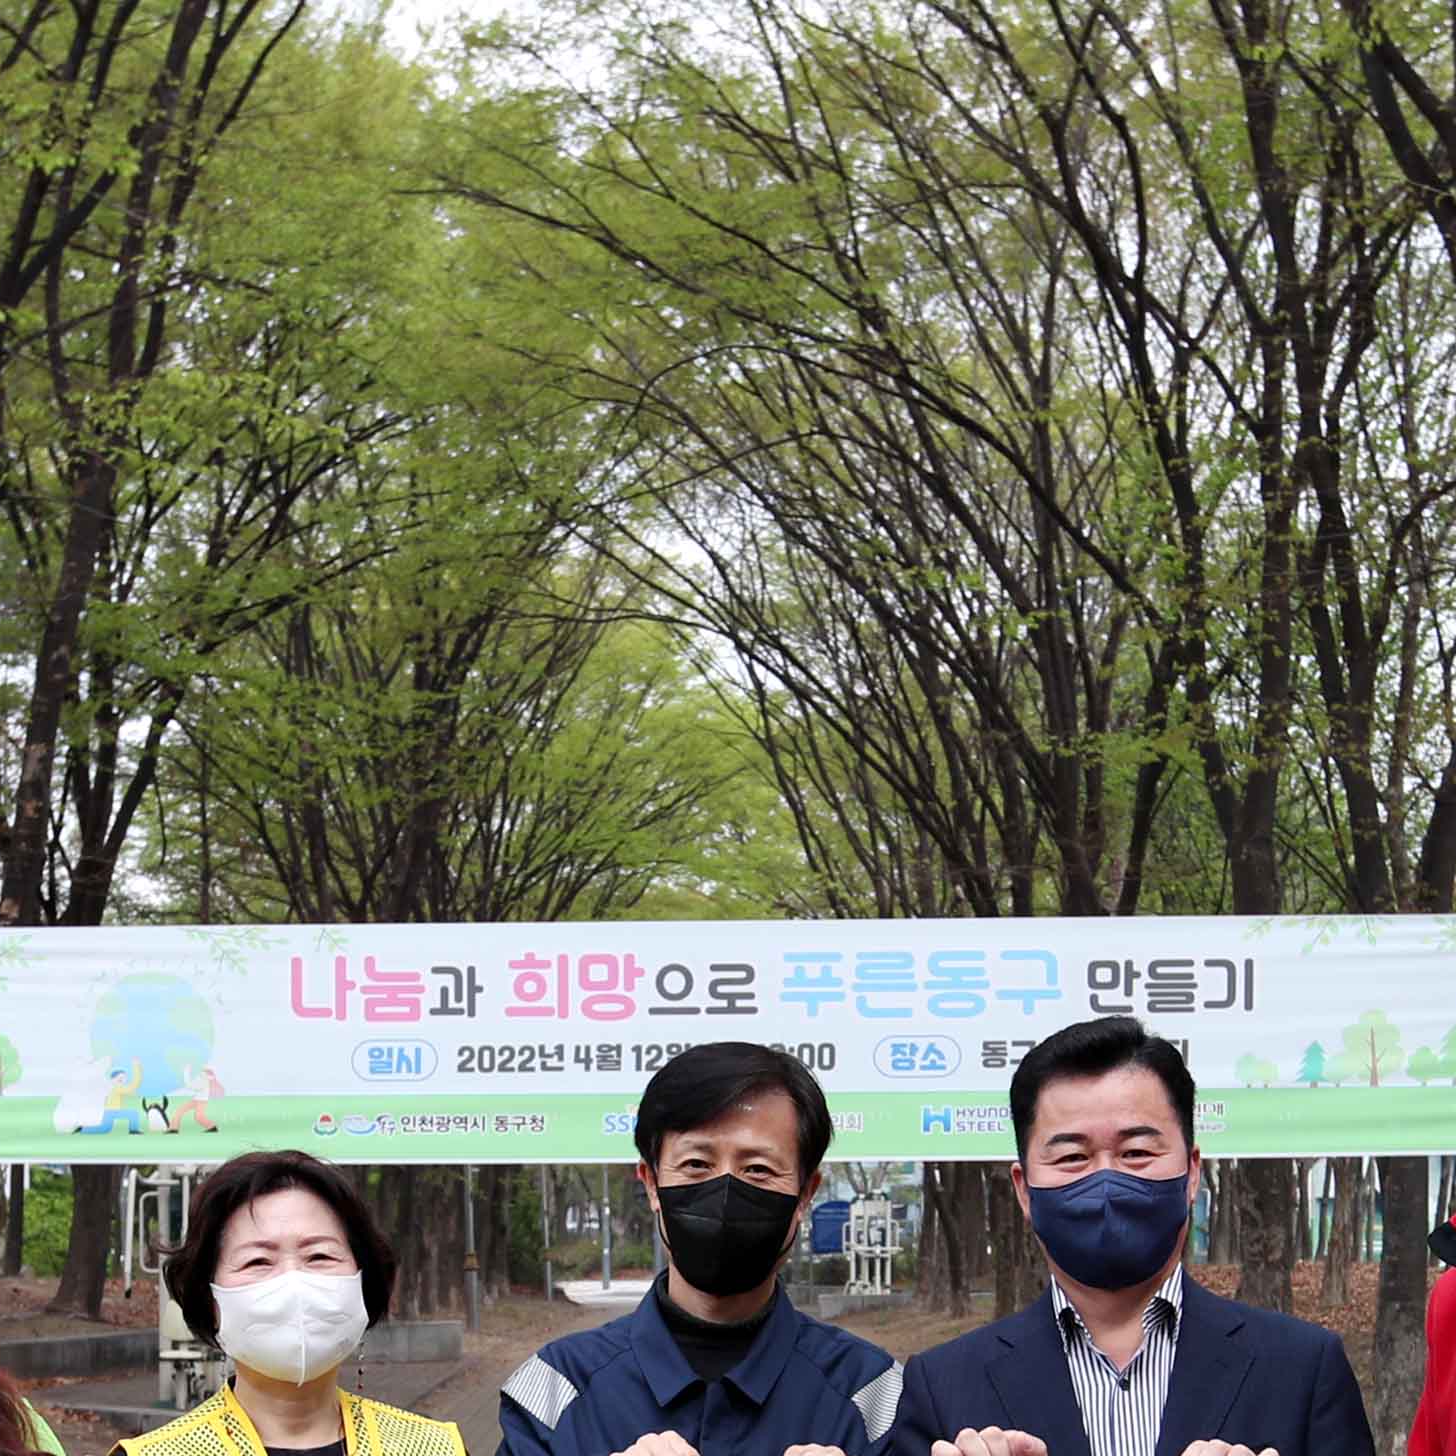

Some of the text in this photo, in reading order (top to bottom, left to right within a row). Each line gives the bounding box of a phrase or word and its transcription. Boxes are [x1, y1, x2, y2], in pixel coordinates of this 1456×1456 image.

[290, 950, 1254, 1022] 나눔과 희망으로 푸른동구 만들기
[367, 1046, 423, 1075] 일시
[456, 1043, 565, 1073] 2022년
[573, 1043, 623, 1073] 4월
[890, 1042, 947, 1072] 장소
[401, 1115, 486, 1133] 인천광역시
[494, 1115, 545, 1133] 동구청
[955, 1106, 1010, 1119] HYUND
[956, 1120, 1006, 1133] STEEL
